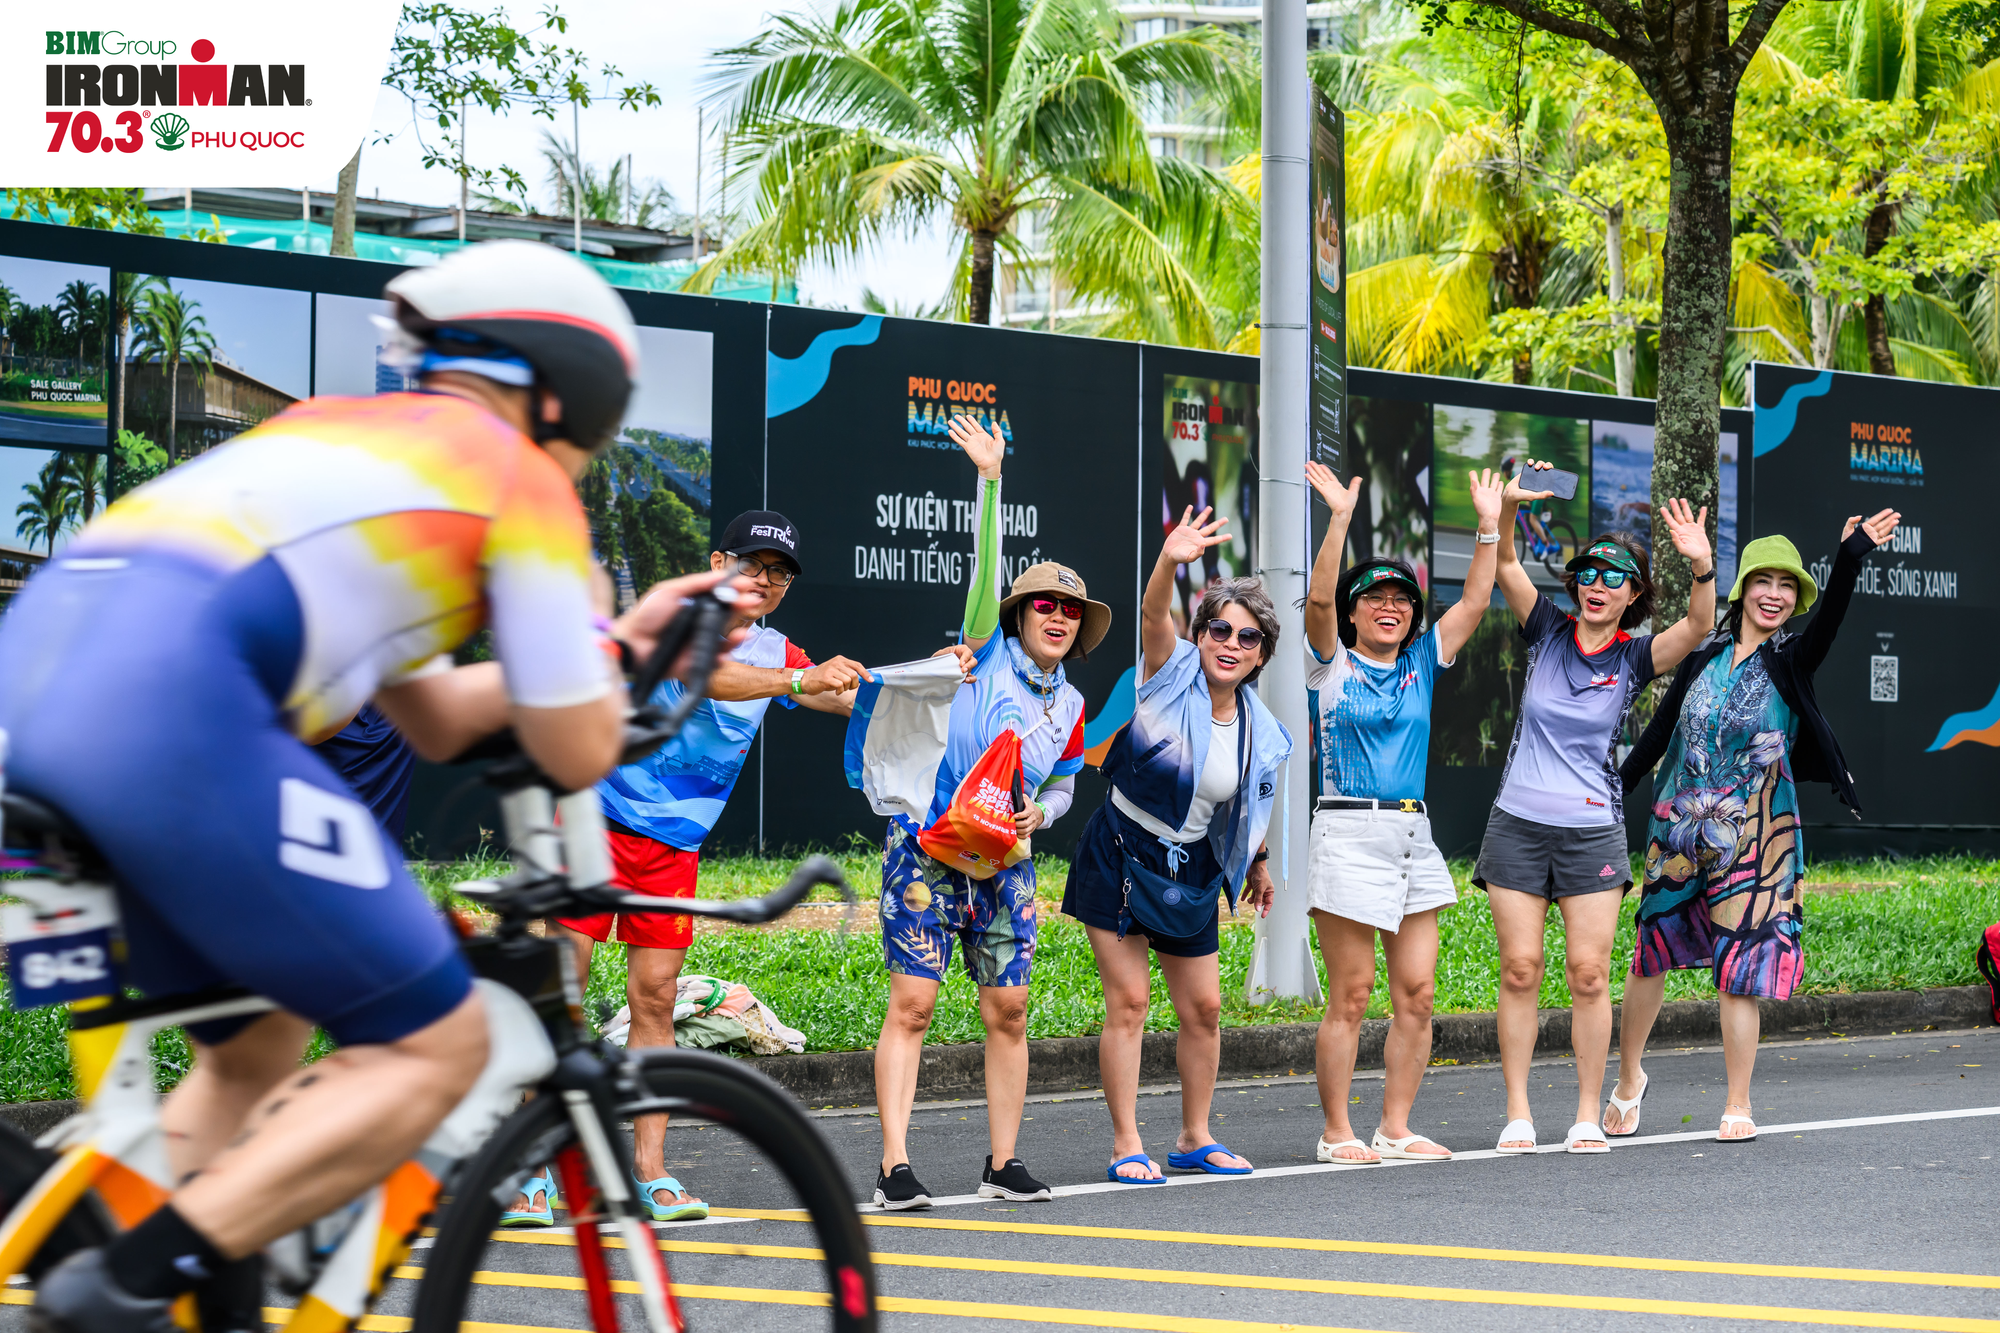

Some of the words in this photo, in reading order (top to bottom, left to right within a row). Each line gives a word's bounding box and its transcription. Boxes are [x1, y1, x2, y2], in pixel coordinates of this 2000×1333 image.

[30, 379, 49, 390] SALE
[51, 380, 82, 391] GALLERY
[31, 390, 48, 401] PHU
[50, 391, 73, 403] QUOC
[74, 393, 102, 403] MARINA
[908, 376, 942, 399] PHU
[946, 380, 997, 404] QUOC
[1172, 421, 1199, 442] 70.3
[1850, 421, 1874, 441] PHU
[1877, 424, 1912, 445] QUOC
[1850, 442, 1924, 475] MARINA
[876, 493, 902, 536] SỰ
[905, 491, 948, 538] KIỆN
[1001, 503, 1038, 538] HAO
[1892, 525, 1922, 554] GIAN
[855, 545, 905, 582] DANH
[911, 541, 962, 585] TIẾNG
[1888, 561, 1921, 597] SỐNG
[1924, 570, 1957, 599] XANH
